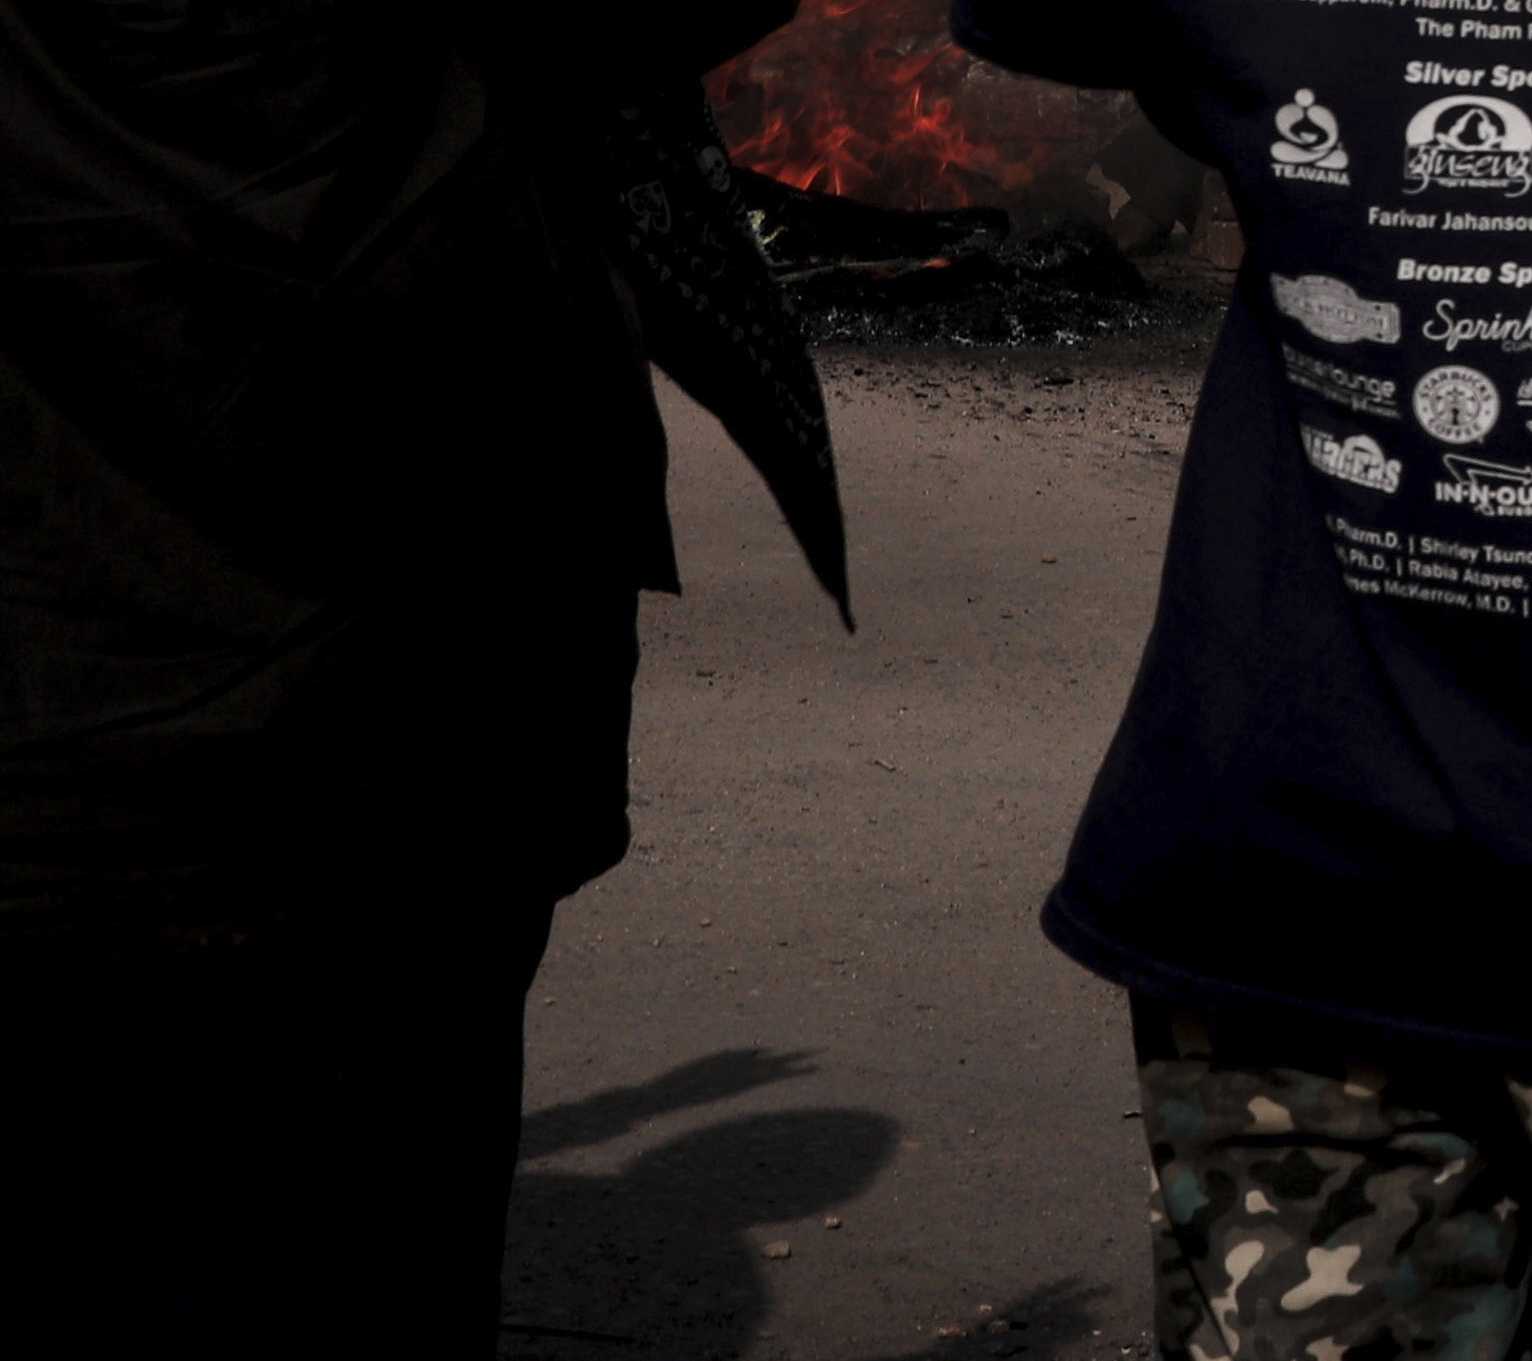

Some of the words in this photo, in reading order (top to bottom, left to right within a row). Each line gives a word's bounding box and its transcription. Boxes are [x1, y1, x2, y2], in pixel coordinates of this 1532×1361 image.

[1415, 17, 1454, 38] The
[1460, 19, 1522, 41] Pham
[1404, 60, 1485, 87] Silver
[1270, 163, 1350, 186] TEAVANA
[1368, 207, 1437, 229] Farivar
[1397, 258, 1491, 284] Bronze
[1408, 559, 1459, 581] Rabia
